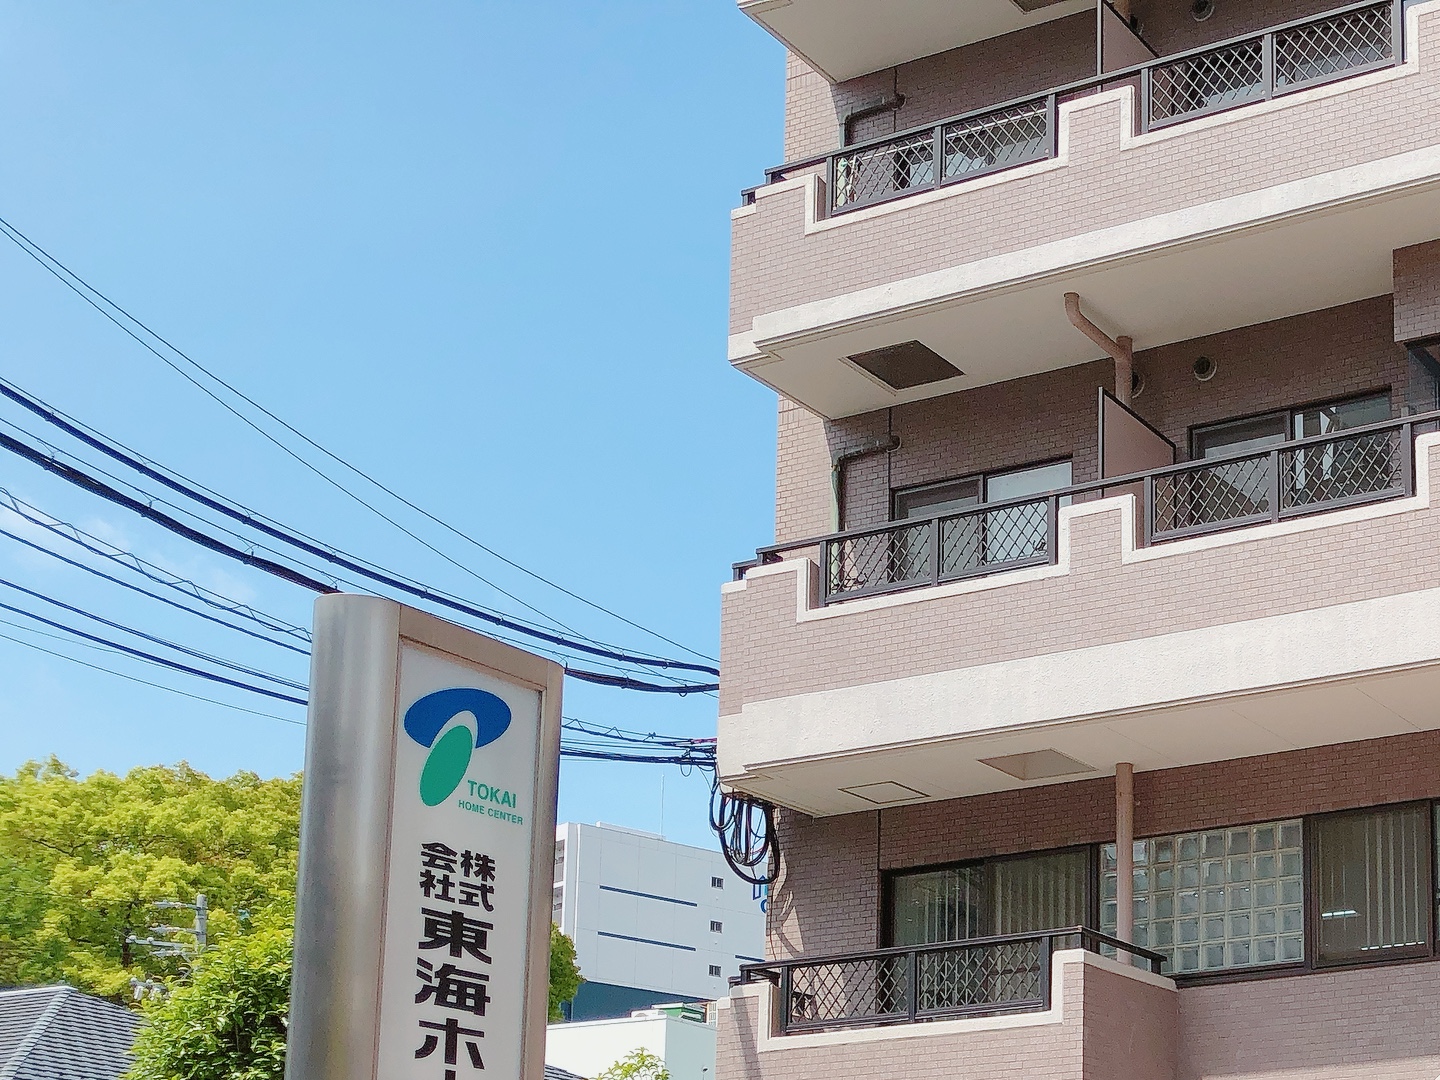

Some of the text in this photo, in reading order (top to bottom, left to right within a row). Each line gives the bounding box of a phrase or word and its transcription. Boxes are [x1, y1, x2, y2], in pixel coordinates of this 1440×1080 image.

[467, 780, 517, 809] TOKAI
[458, 799, 523, 825] HOME CENTER
